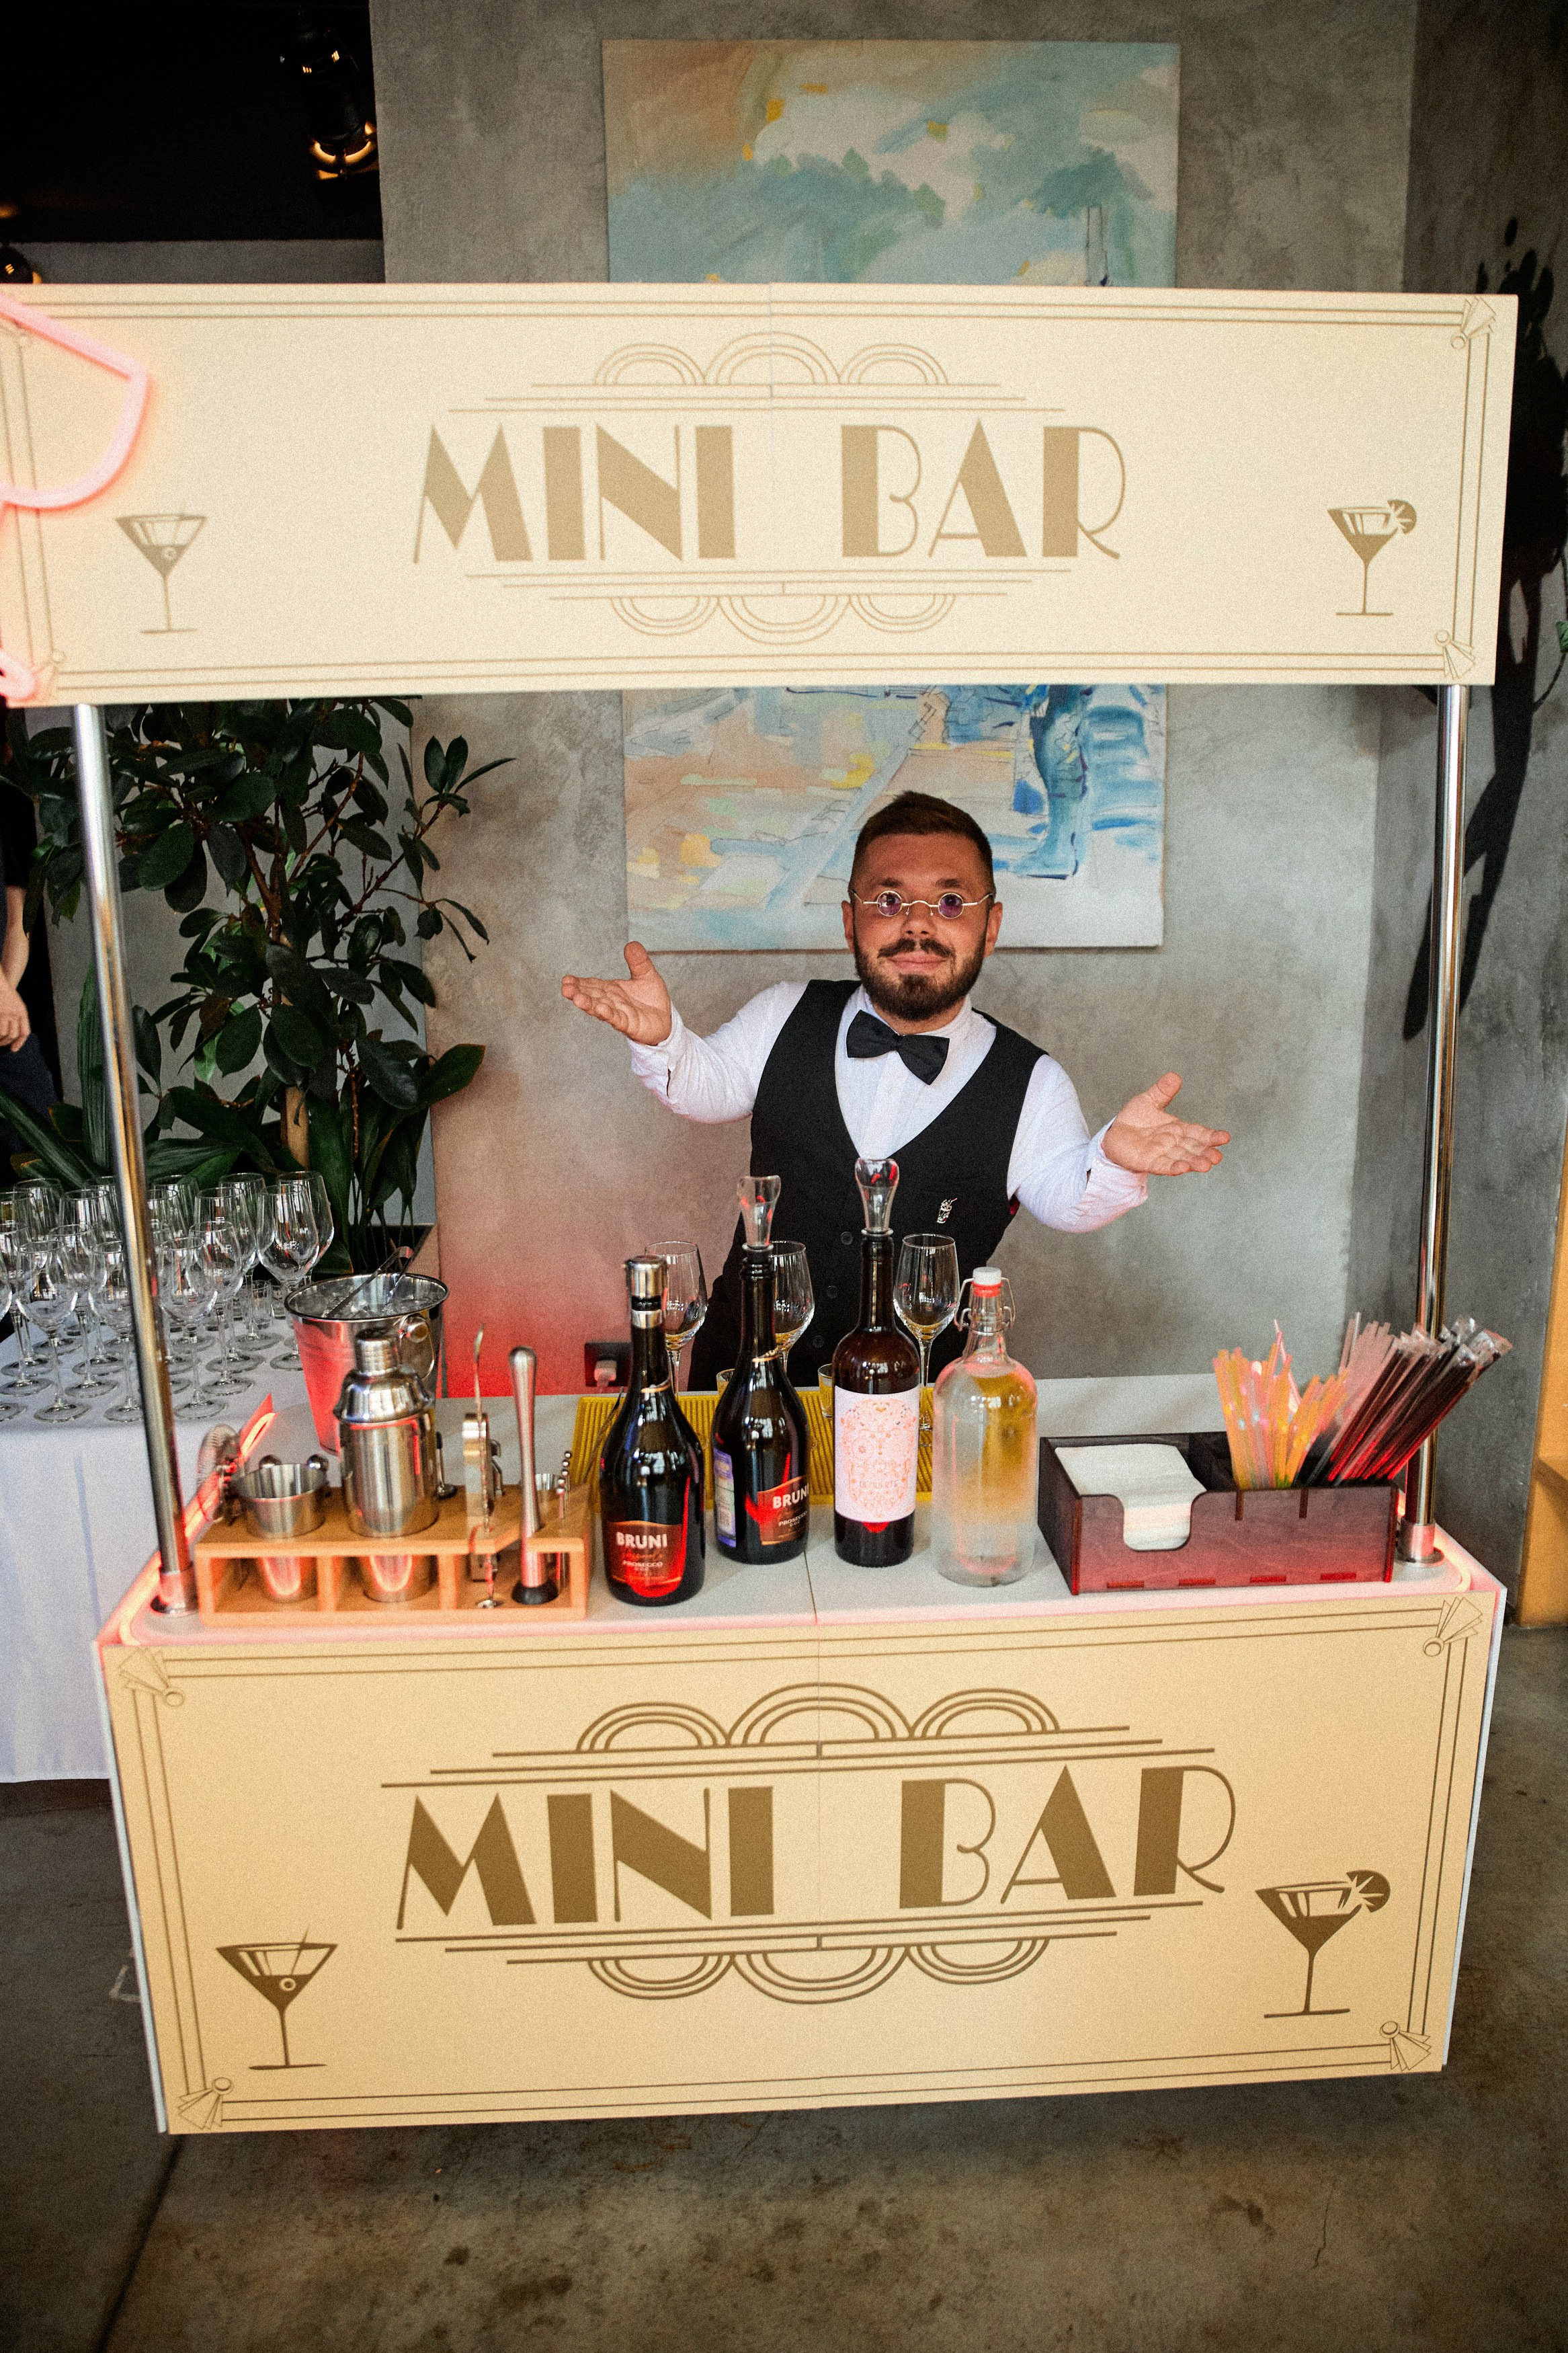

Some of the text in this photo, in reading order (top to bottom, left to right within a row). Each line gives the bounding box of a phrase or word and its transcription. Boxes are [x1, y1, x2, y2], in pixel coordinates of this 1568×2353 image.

[413, 417, 1126, 563] MINI BAR
[772, 1482, 809, 1509] BRUNI
[616, 1531, 668, 1549] BRUNI
[397, 1764, 1237, 1929] MINI BAR
